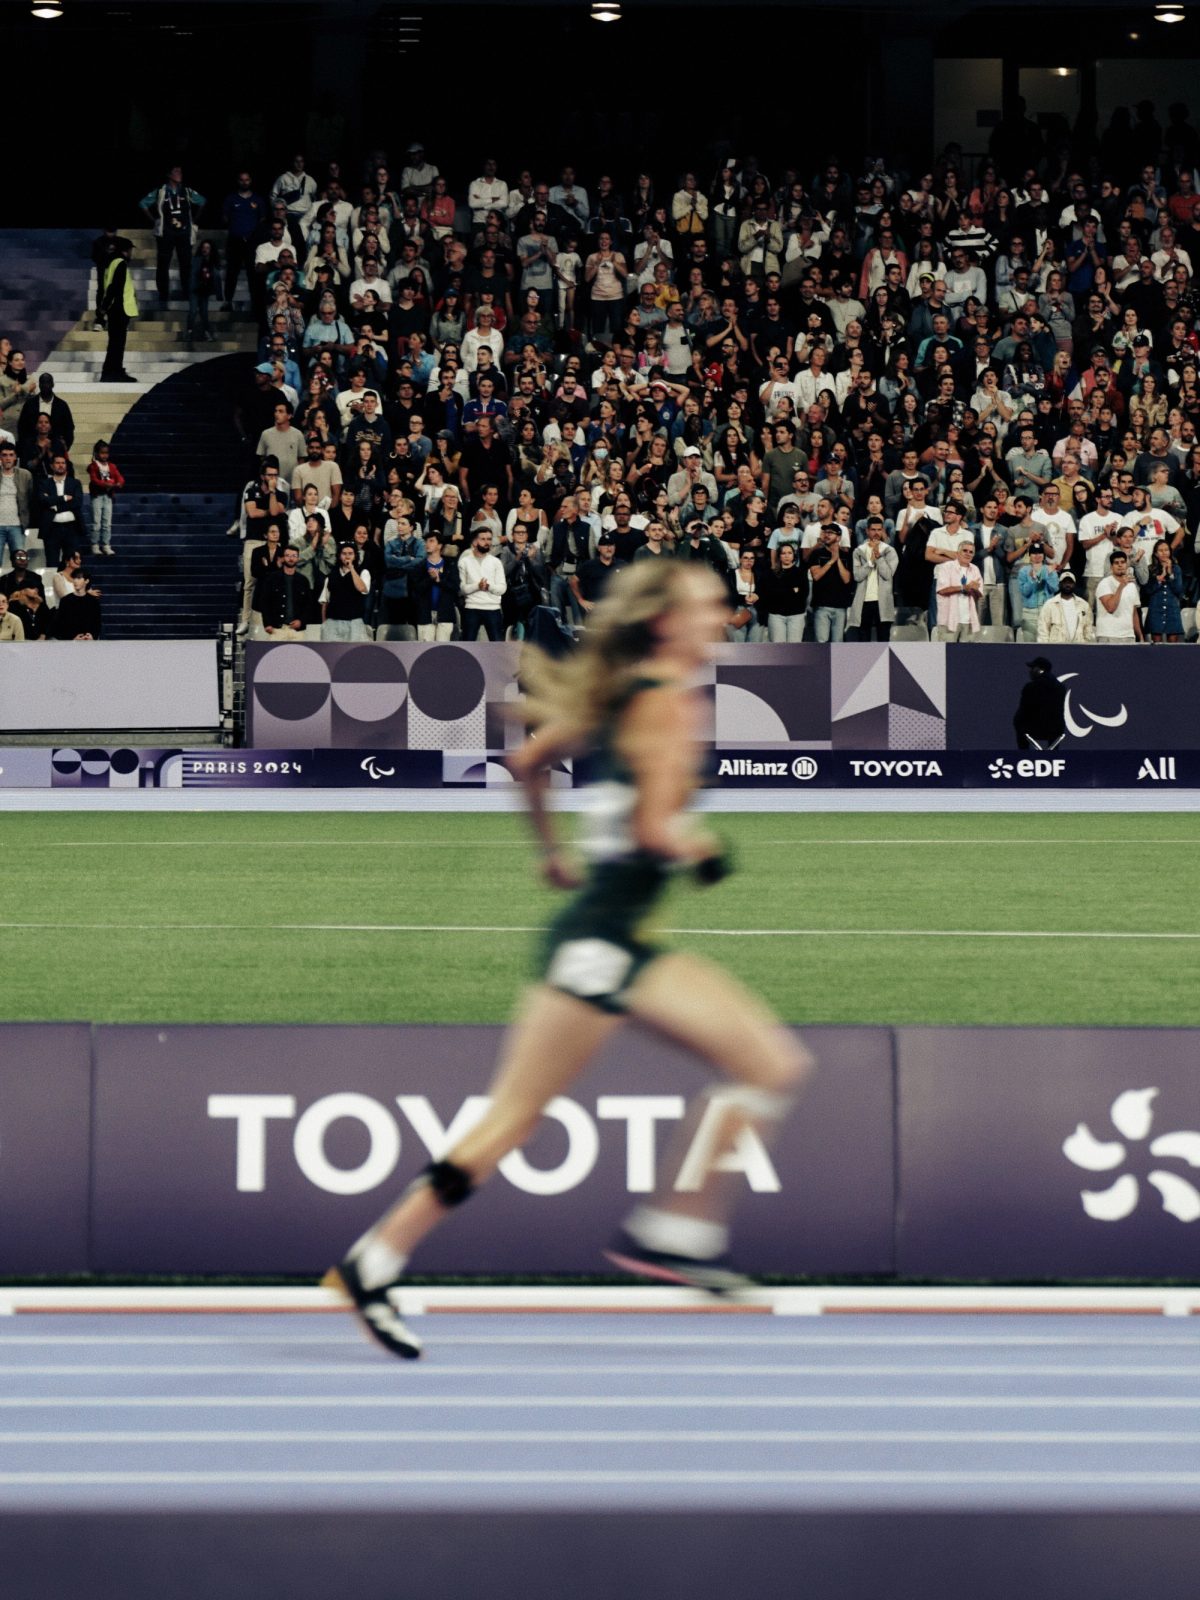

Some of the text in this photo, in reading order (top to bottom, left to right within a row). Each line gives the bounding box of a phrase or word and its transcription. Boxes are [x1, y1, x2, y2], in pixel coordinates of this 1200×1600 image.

[253, 762, 302, 773] 2024
[718, 759, 788, 775] Allianz
[850, 760, 942, 776] TOYOTA
[207, 1093, 781, 1195] TOYOTA
